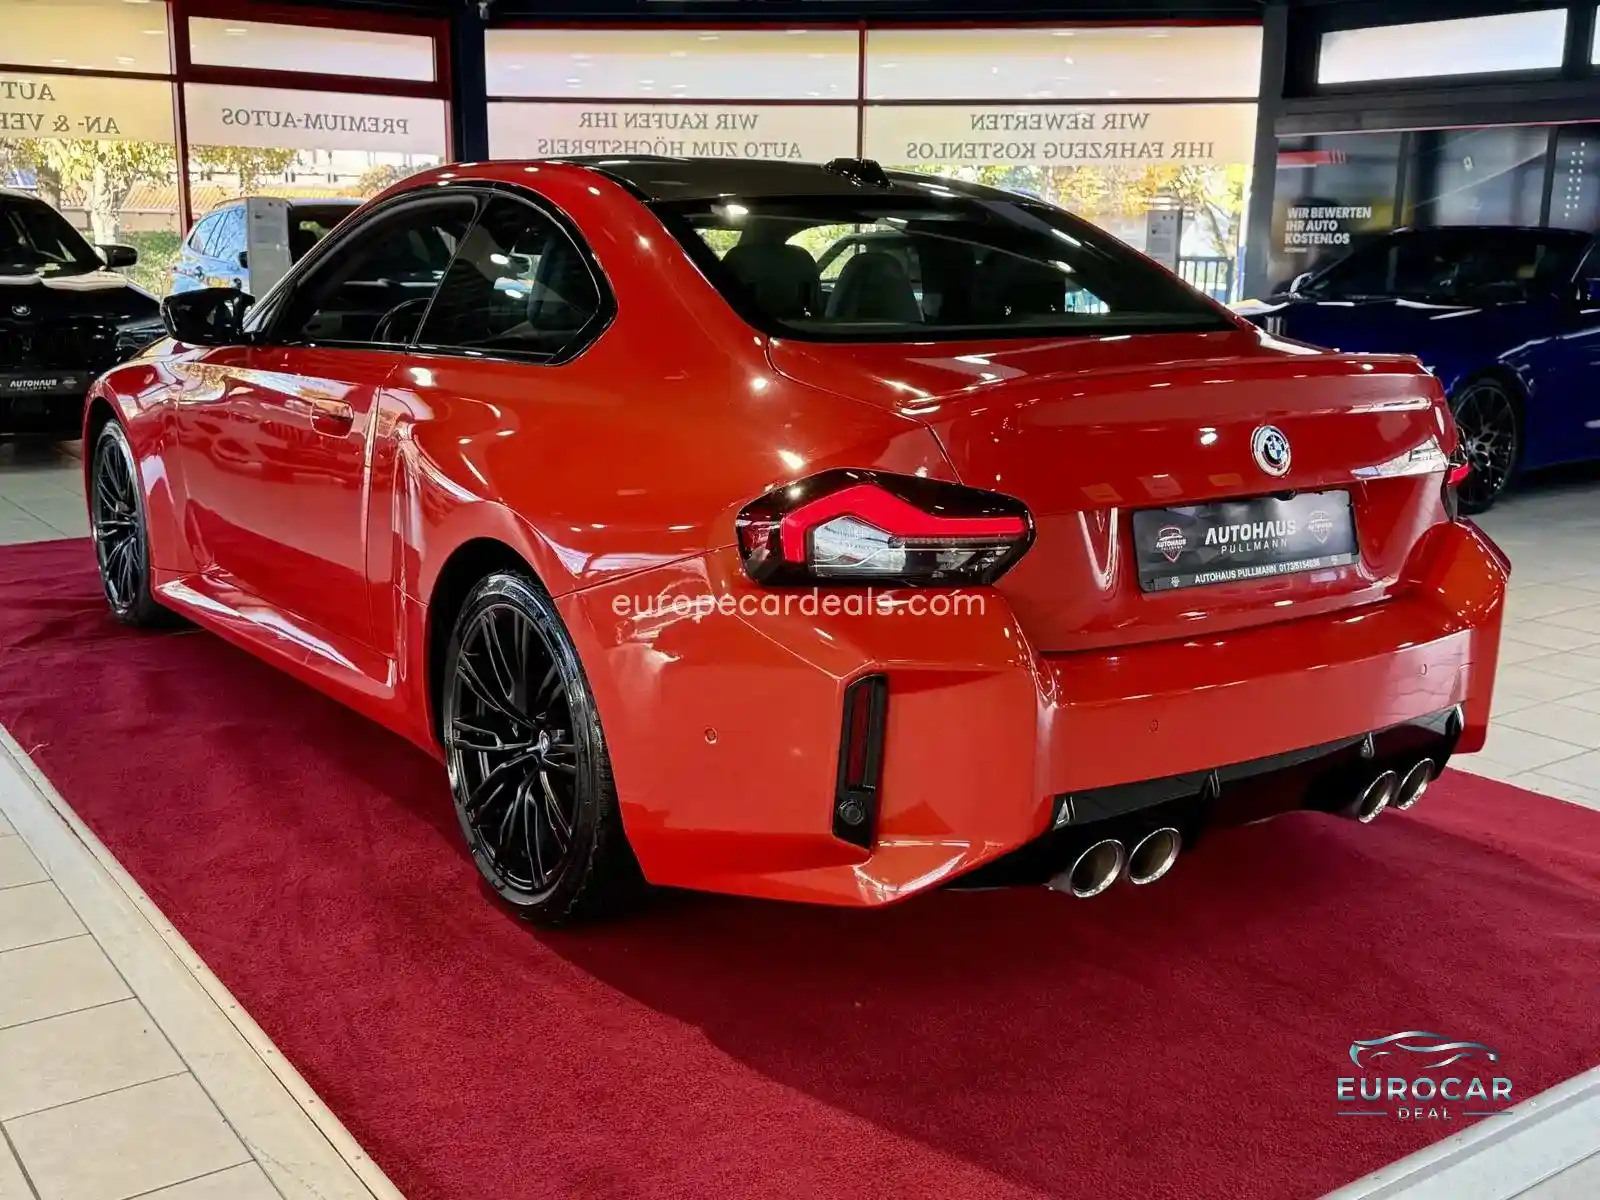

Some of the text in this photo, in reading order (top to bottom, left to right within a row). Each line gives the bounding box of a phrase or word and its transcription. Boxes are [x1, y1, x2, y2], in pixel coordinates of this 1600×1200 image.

[1287, 206, 1372, 218] WIR BEWERTEN
[1285, 220, 1338, 231] IHR AUTO
[1284, 232, 1350, 244] KOSTENLOS
[1204, 520, 1297, 545] AUTOHAUS
[1221, 538, 1287, 554] PULLMANN
[1194, 569, 1237, 584] AUTOHAUS
[1237, 564, 1277, 578] PULLMANN
